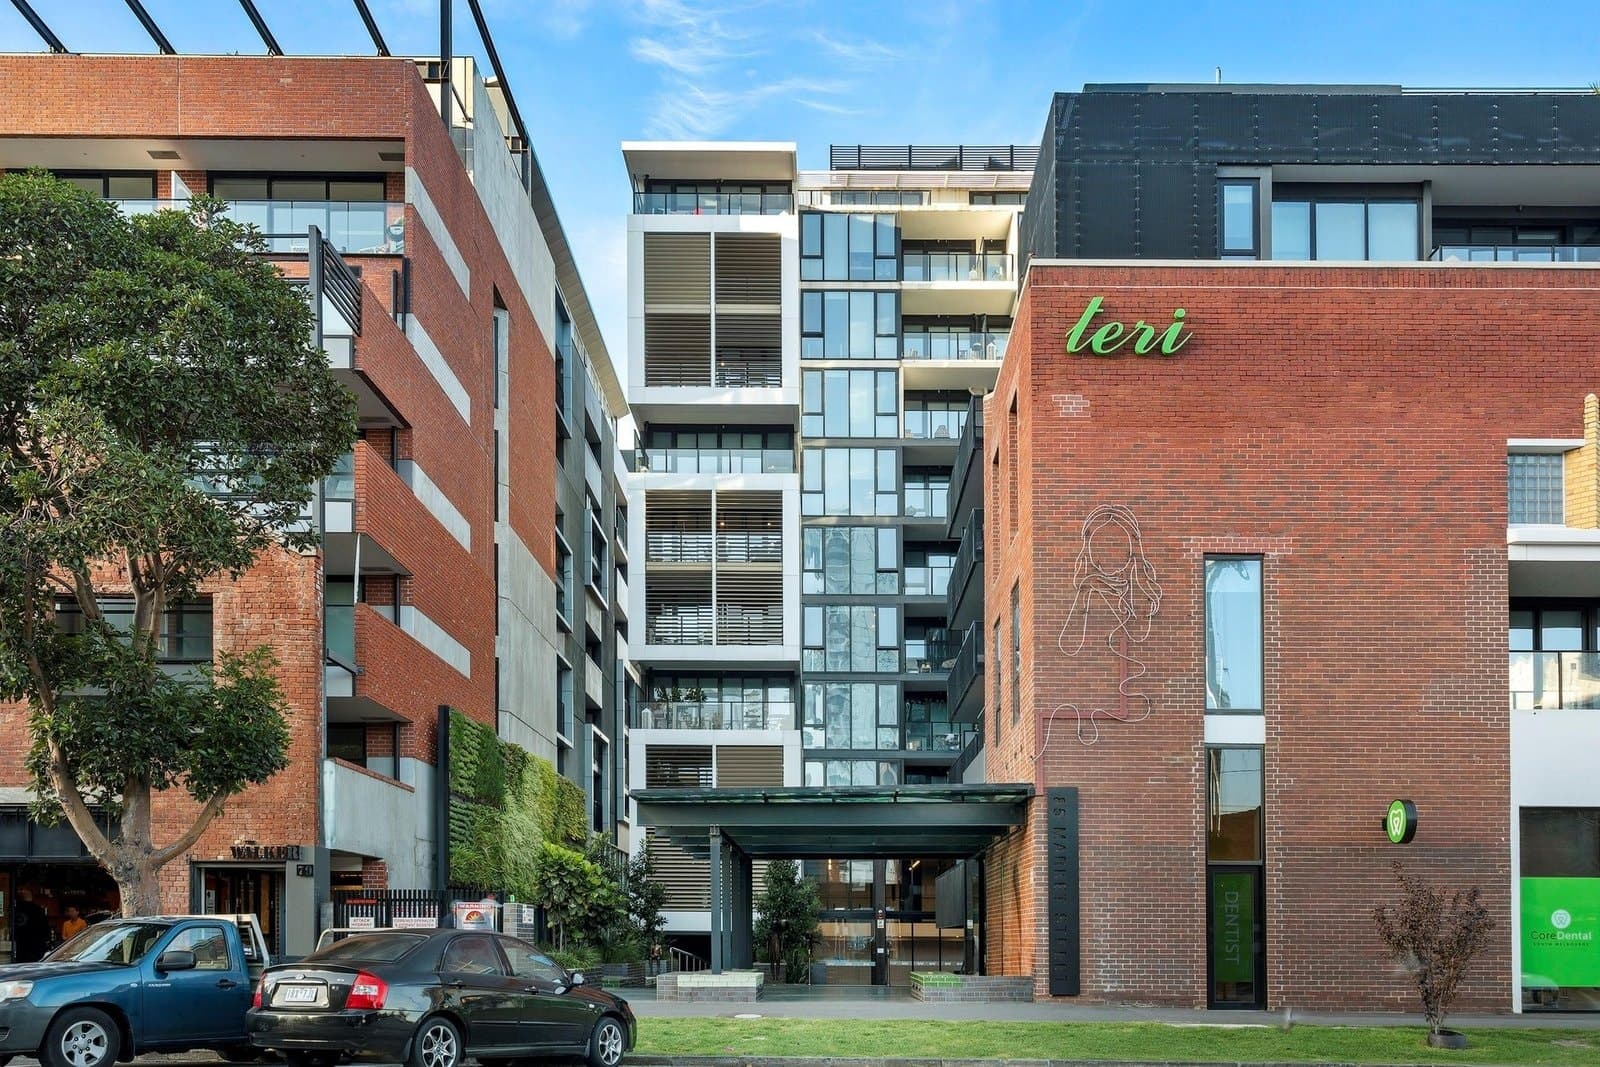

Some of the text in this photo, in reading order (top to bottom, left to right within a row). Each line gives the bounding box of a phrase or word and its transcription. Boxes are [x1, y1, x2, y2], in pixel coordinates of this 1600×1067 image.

[1065, 296, 1193, 356] teri
[230, 845, 299, 860] WALKER
[1225, 891, 1240, 965] DENTIST
